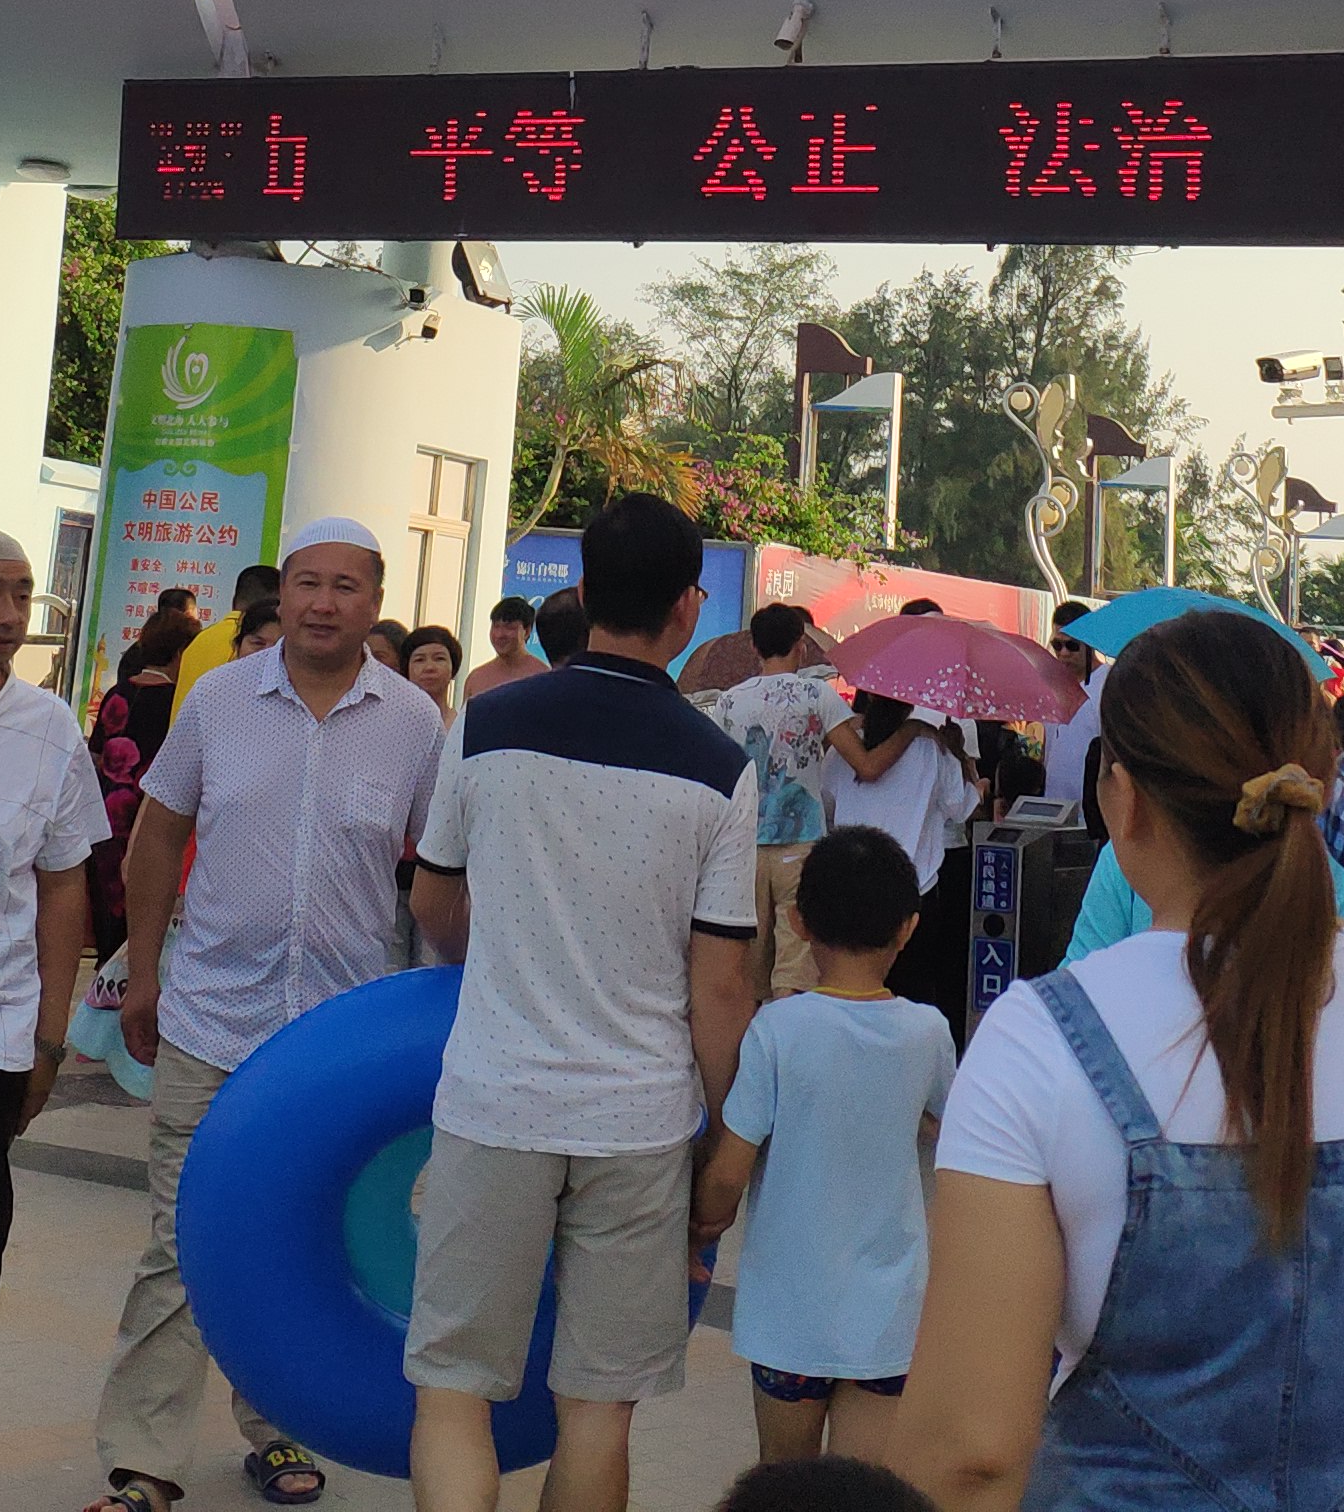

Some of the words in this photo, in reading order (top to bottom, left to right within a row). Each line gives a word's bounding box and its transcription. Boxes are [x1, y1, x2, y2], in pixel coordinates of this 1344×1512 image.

[409, 110, 587, 202] 平等
[693, 104, 880, 201] 公正
[999, 100, 1213, 201] 法治
[142, 489, 220, 513] 中国公民
[122, 520, 239, 547] 文明旅游公约
[981, 943, 1004, 995] 入口
